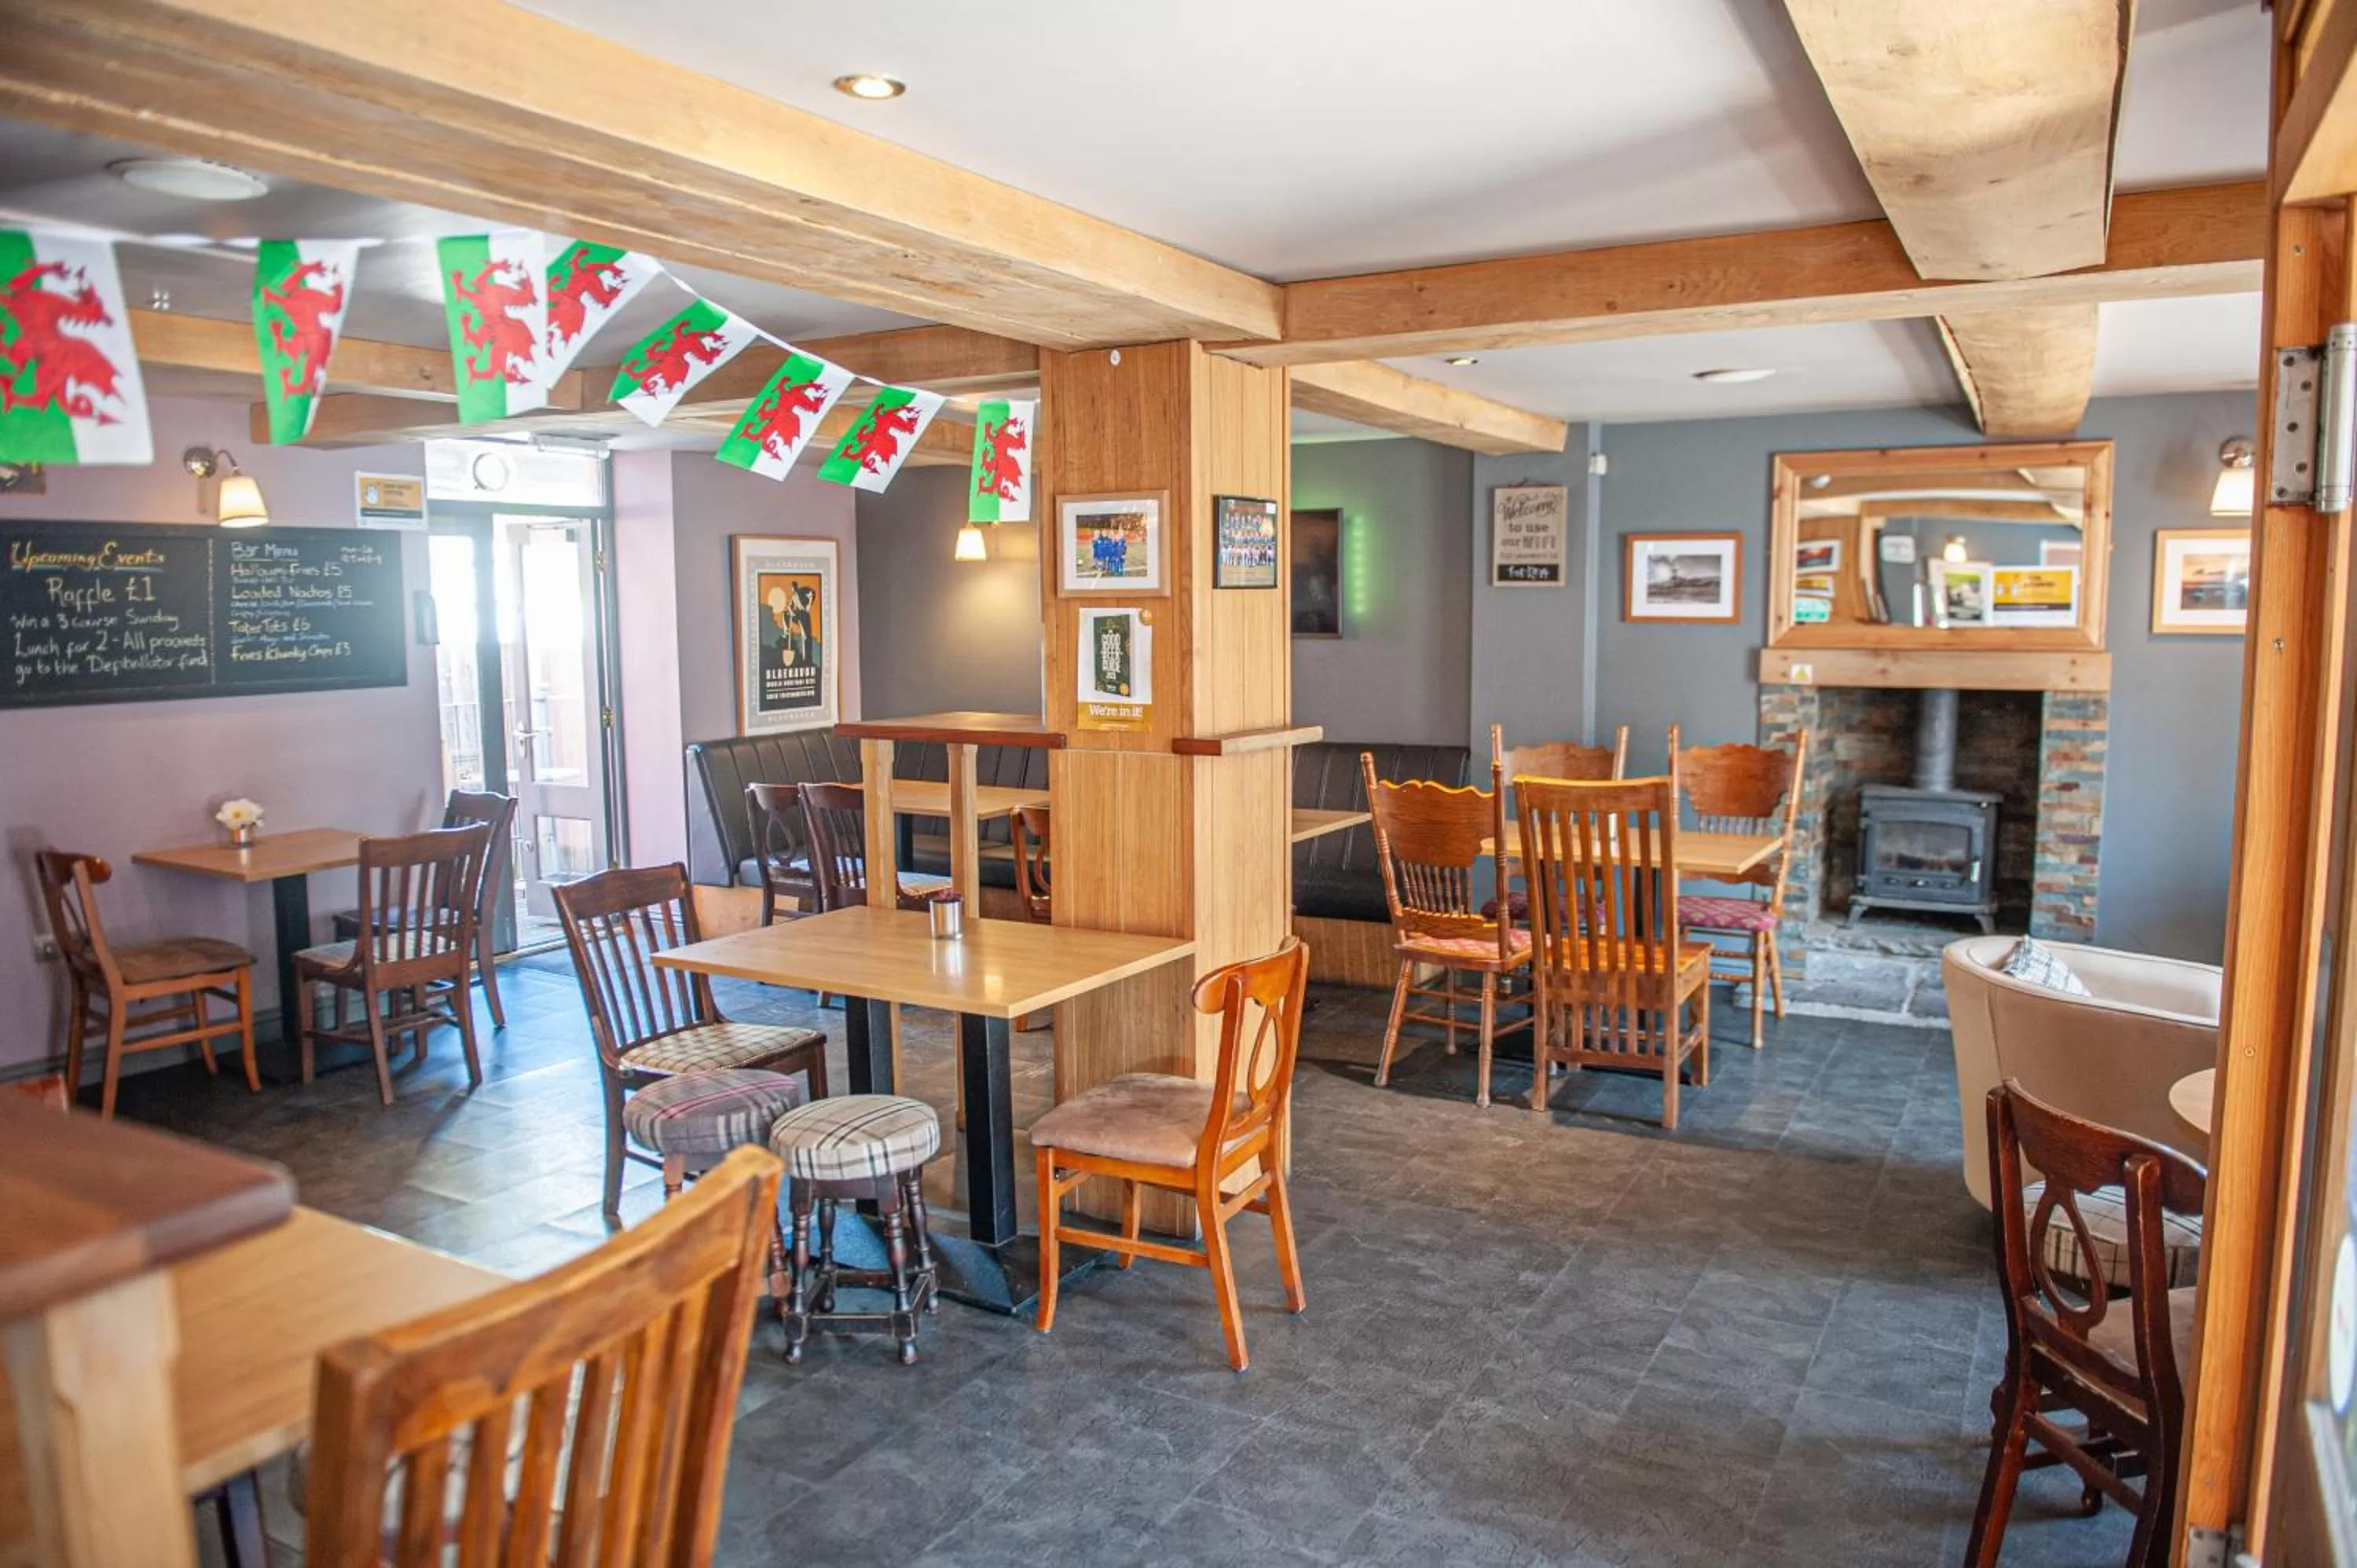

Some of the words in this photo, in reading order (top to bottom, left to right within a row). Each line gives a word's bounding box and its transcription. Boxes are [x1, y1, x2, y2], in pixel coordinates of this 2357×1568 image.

[1508, 522, 1522, 533] to
[1525, 524, 1549, 533] use
[11, 540, 97, 573] Upcoming
[97, 541, 165, 570] Events
[46, 577, 115, 613] Raffle
[126, 575, 156, 602] £1
[232, 585, 281, 599] Loaded
[288, 585, 333, 599] Nachos
[56, 613, 69, 629] 3
[126, 608, 179, 632] Sunday
[16, 632, 60, 658] Lunch
[65, 641, 90, 659] for
[95, 629, 108, 652] 2
[123, 631, 145, 650] All
[15, 665, 32, 685] go
[37, 658, 51, 676] to
[53, 659, 78, 676] the
[177, 648, 209, 671] fund
[1088, 703, 1118, 717] We're
[1120, 705, 1131, 717] in
